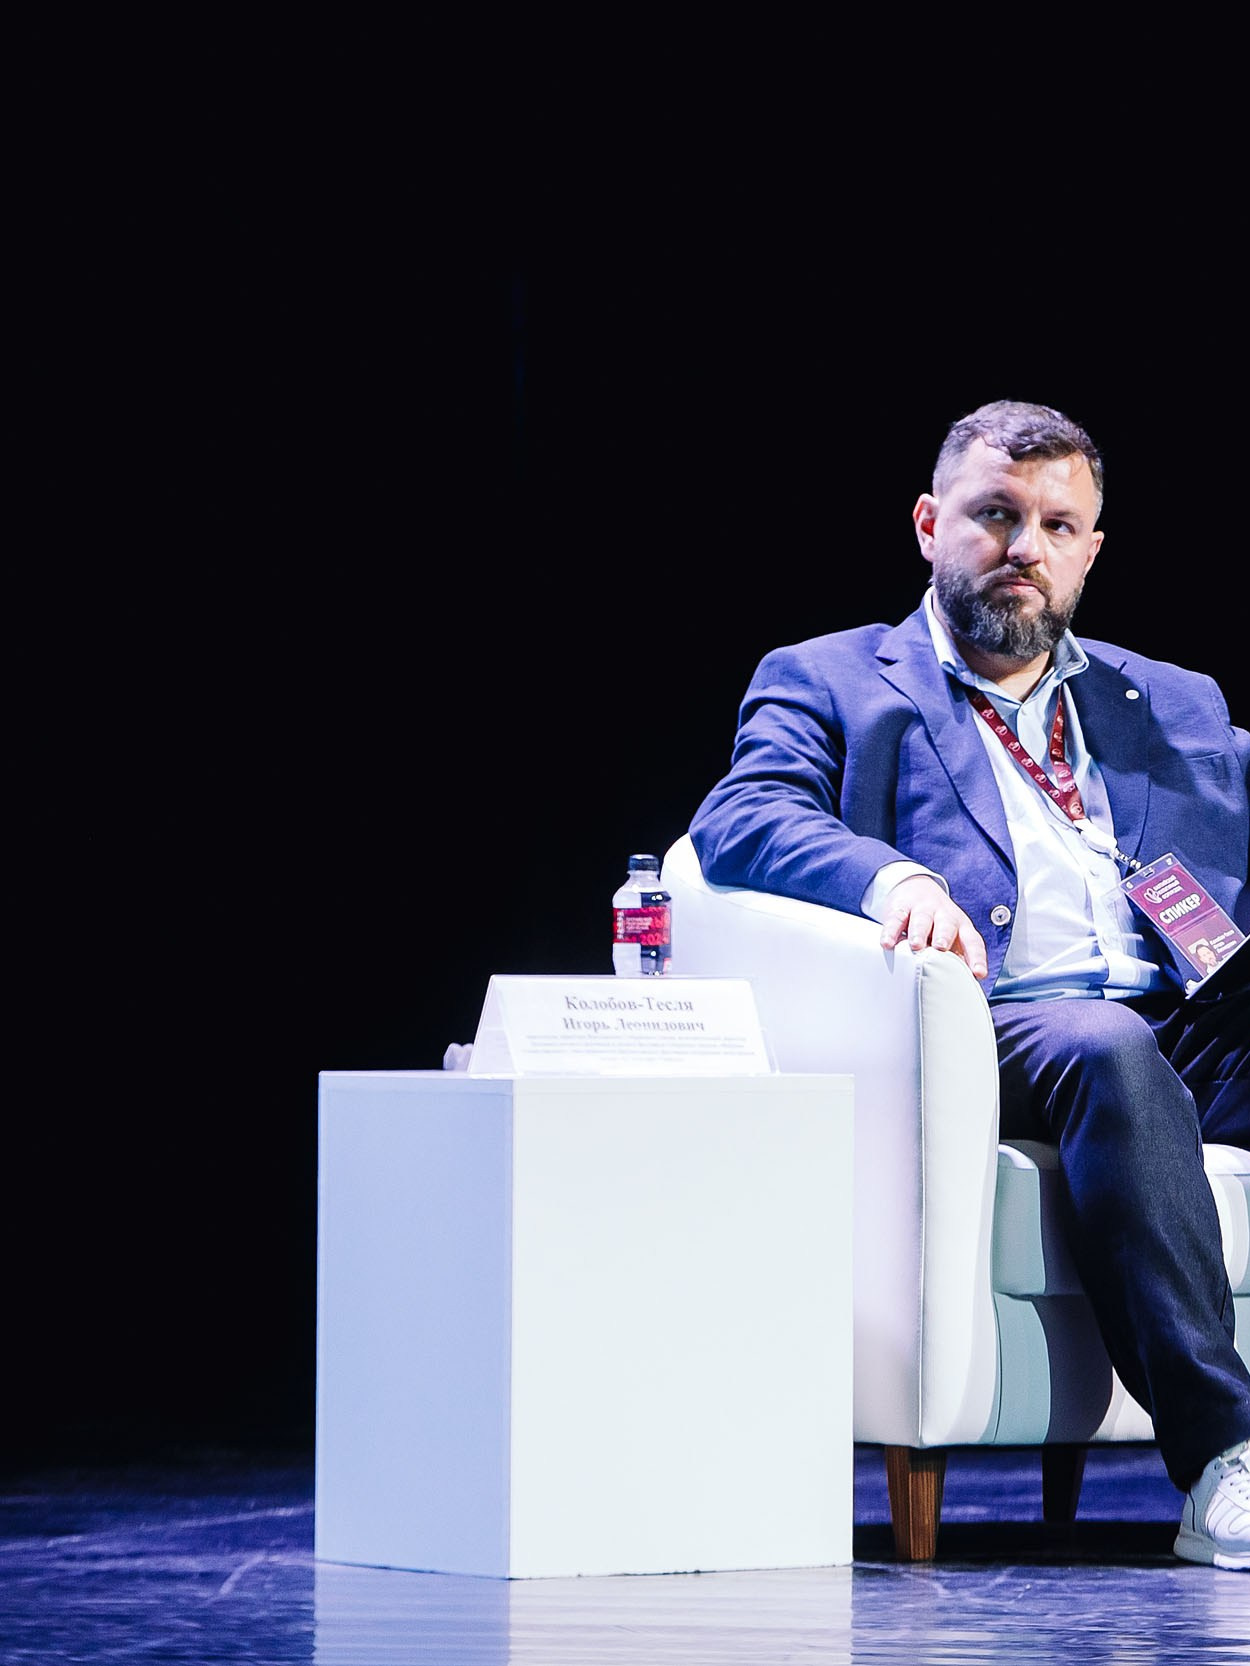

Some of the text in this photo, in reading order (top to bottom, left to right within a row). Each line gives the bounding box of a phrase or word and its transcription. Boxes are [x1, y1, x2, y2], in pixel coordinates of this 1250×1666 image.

[1159, 893, 1201, 924] СПИКЕР
[564, 995, 694, 1012] Колобов-Тесля
[562, 1016, 706, 1033] Игорь Леонидович
